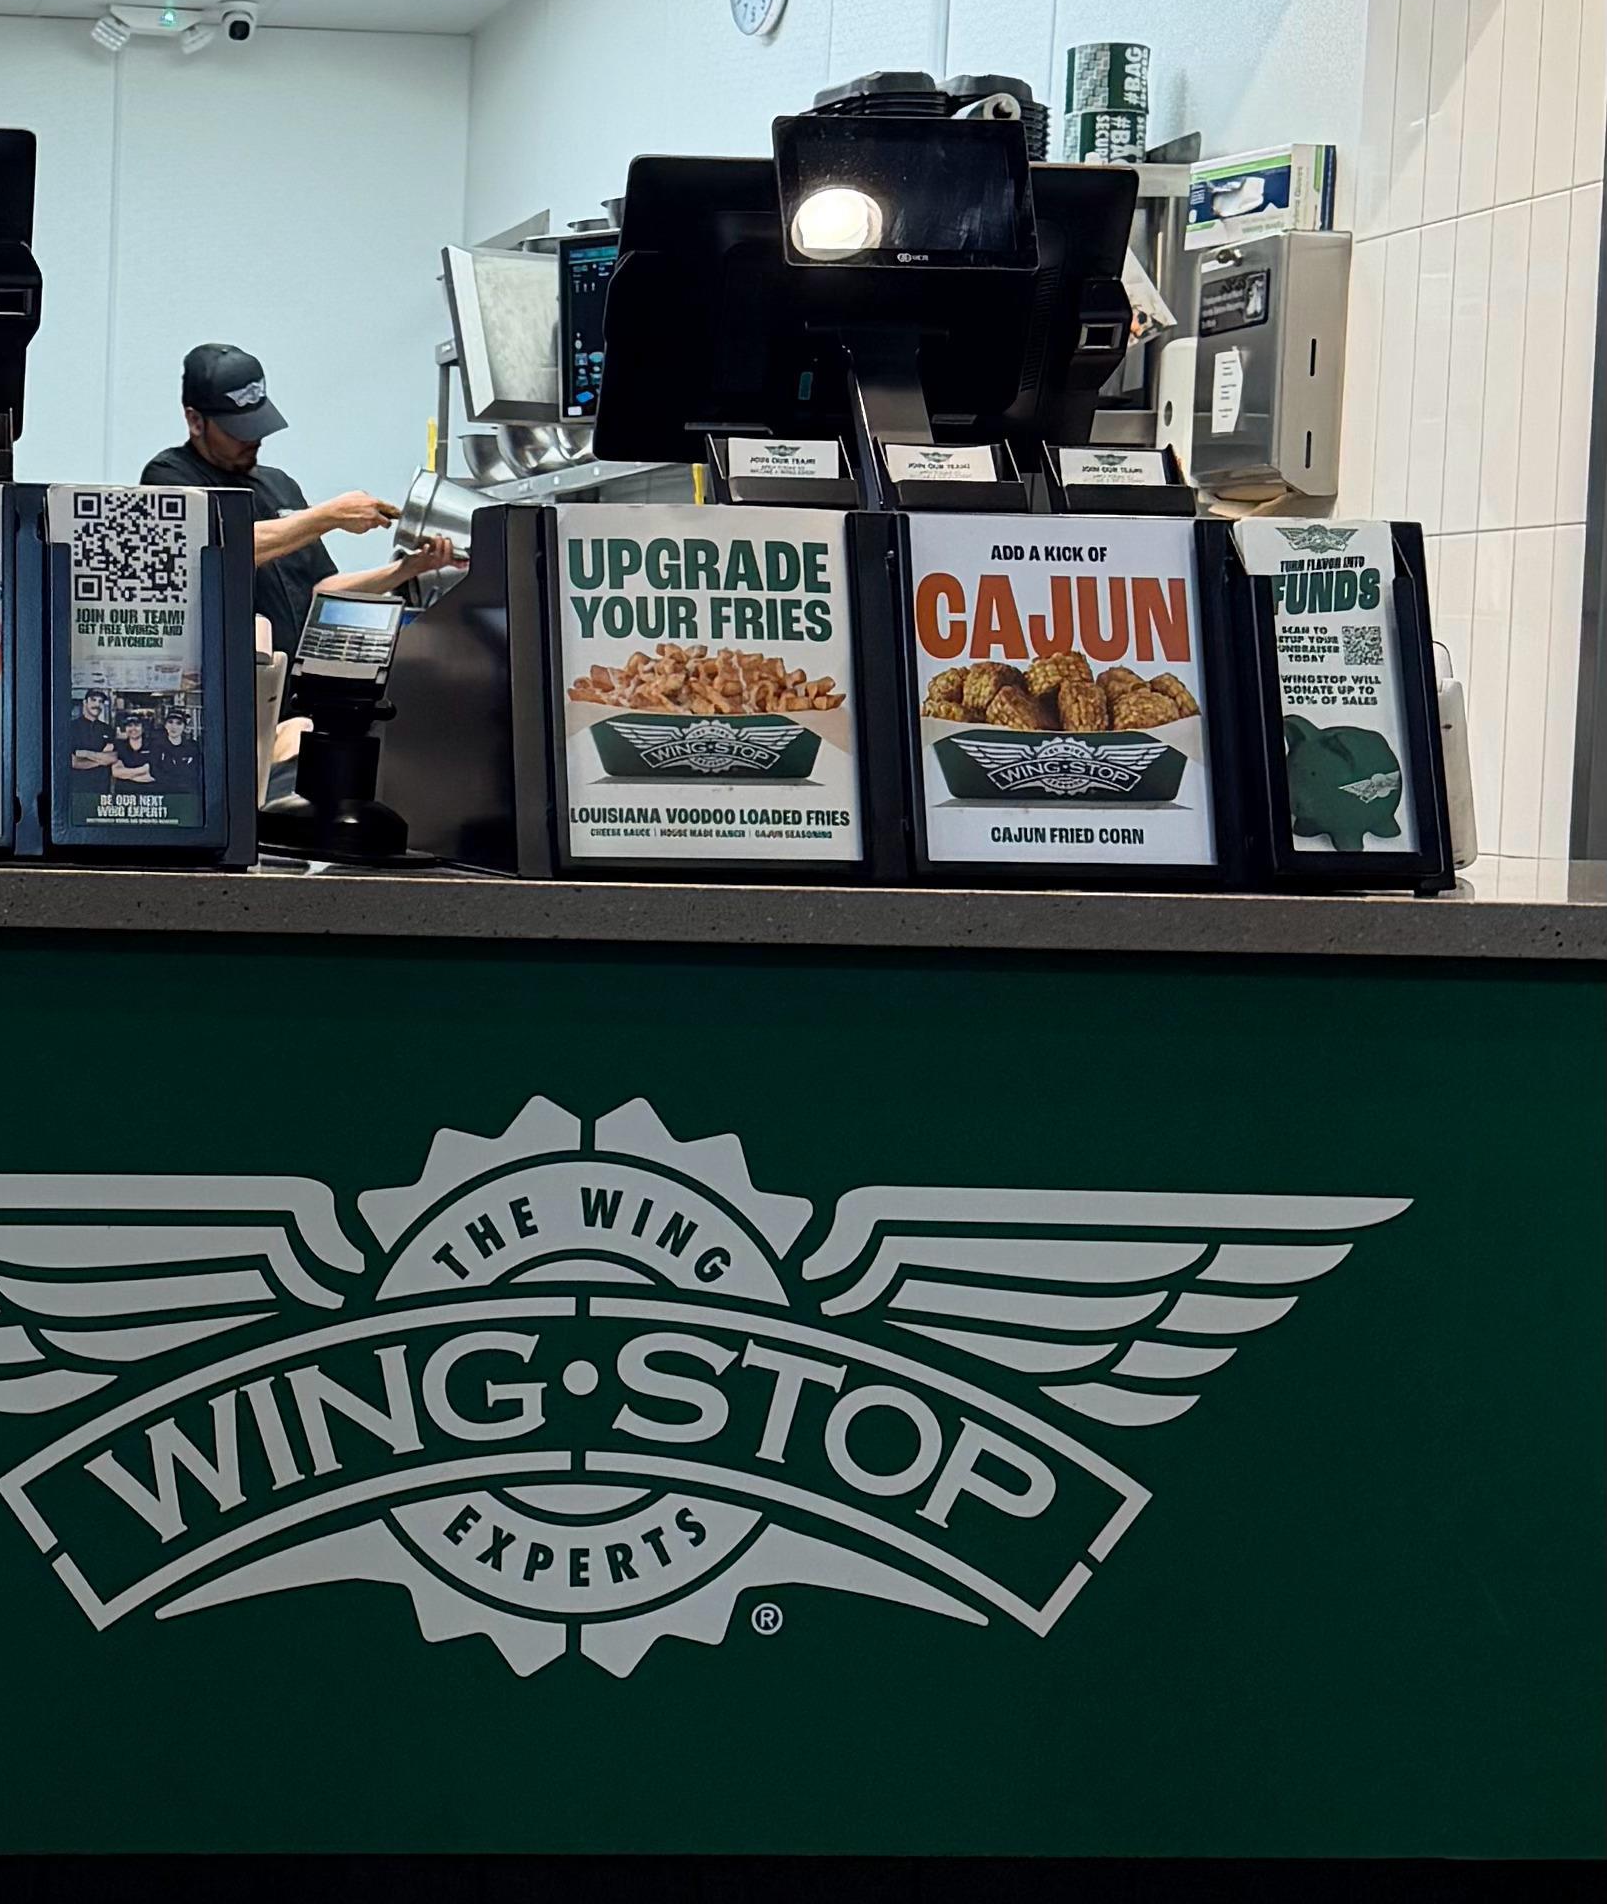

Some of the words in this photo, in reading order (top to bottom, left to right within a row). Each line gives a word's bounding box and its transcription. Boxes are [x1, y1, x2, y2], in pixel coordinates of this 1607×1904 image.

[991, 545, 1024, 561] ADD
[1029, 546, 1040, 561] A
[1044, 545, 1083, 563] KICK
[1087, 546, 1108, 563] OF
[567, 537, 831, 594] UPGRADE
[75, 608, 105, 623] JOIN
[110, 609, 138, 624] OUR
[143, 610, 185, 625] TEAM!
[570, 596, 698, 639] YOUR
[710, 597, 833, 642] FRIES
[915, 572, 1191, 663] CAJUN
[1281, 675, 1347, 684] WINGSTOP
[1352, 676, 1381, 684] WILL
[1283, 686, 1333, 694] DONATE
[1338, 686, 1355, 694] UP
[1359, 686, 1374, 695] TO
[570, 807, 661, 825] LOUISIANA
[665, 808, 735, 825] VOODOO
[739, 809, 803, 826] LOADED
[806, 809, 850, 827] FRIES
[990, 826, 1046, 844] CAJUN
[1050, 827, 1094, 844] FRIED
[1098, 827, 1145, 845] CORN
[430, 1194, 542, 1290] THE
[580, 1185, 738, 1290] WING
[439, 1502, 715, 1591] EXPERTS
